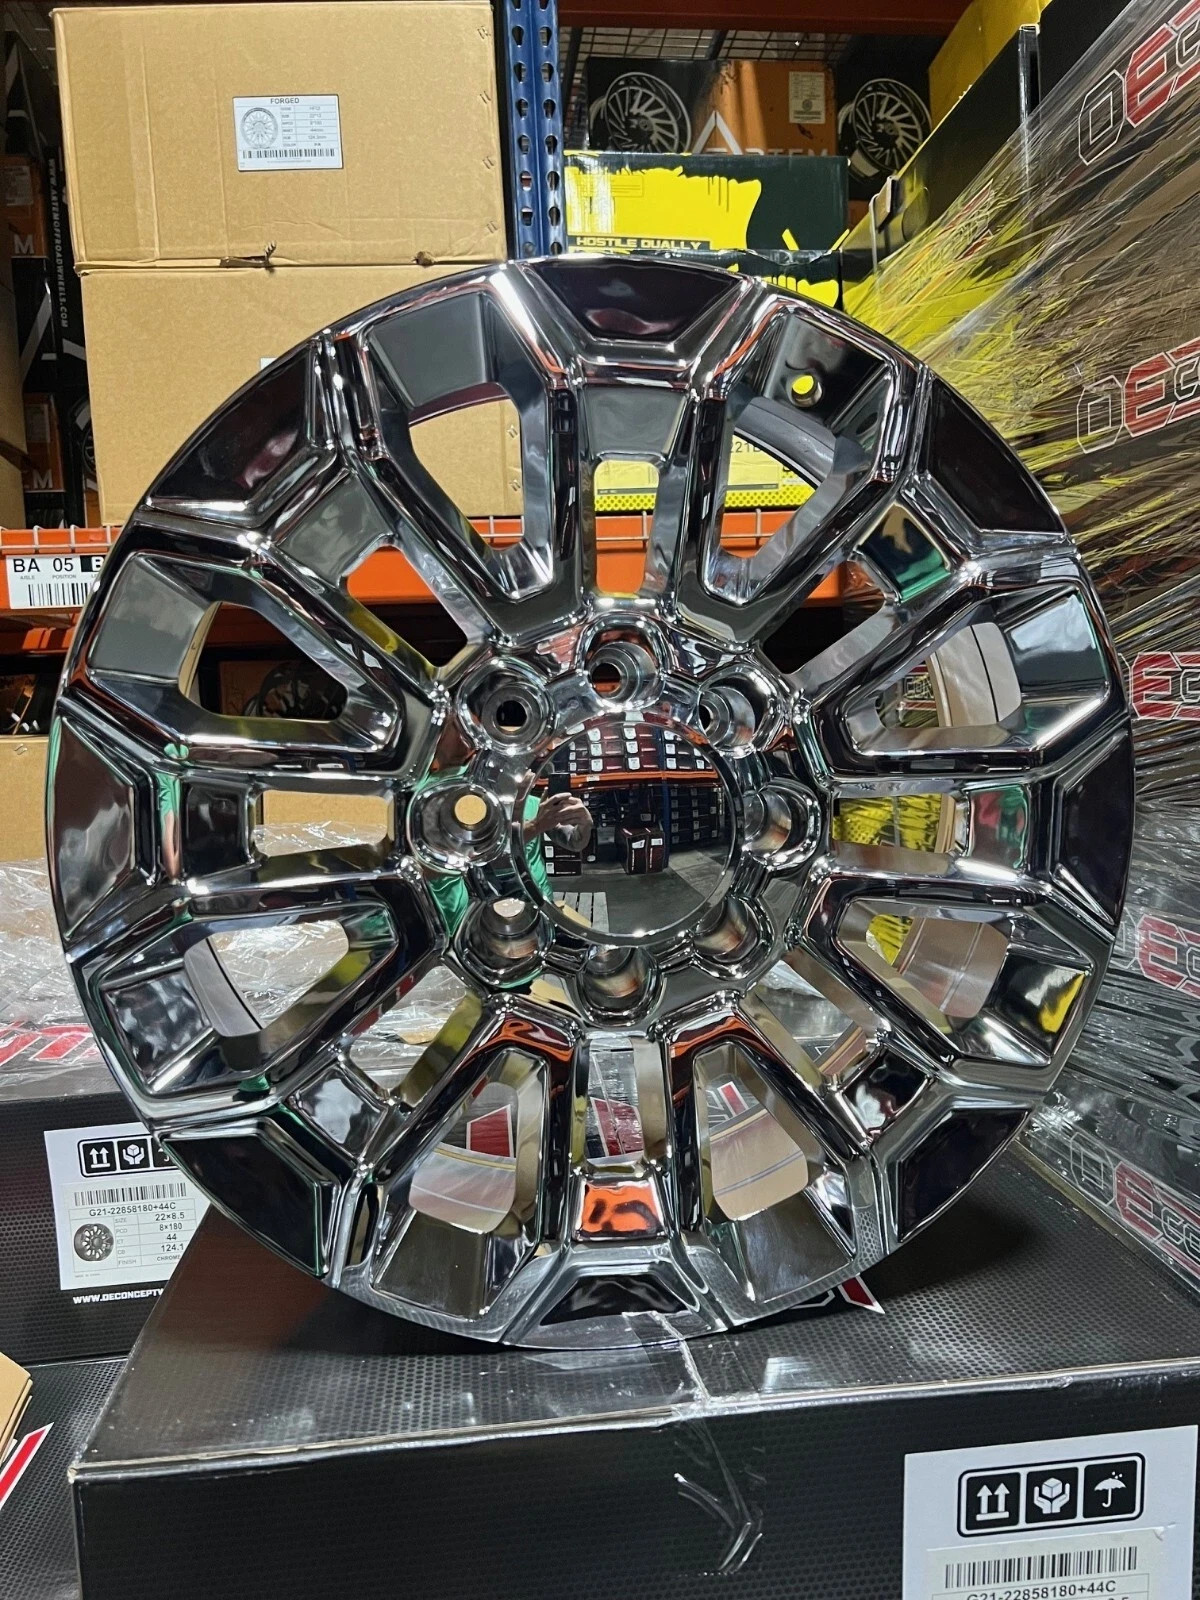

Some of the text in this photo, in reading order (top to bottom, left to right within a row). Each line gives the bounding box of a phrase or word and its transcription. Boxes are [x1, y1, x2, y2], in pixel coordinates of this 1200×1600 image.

[576, 236, 638, 248] HOSTILE
[13, 558, 40, 573] BA
[53, 557, 74, 572] 05
[89, 1202, 177, 1217] G21-22858180+44C
[161, 1243, 184, 1252] 124.1
